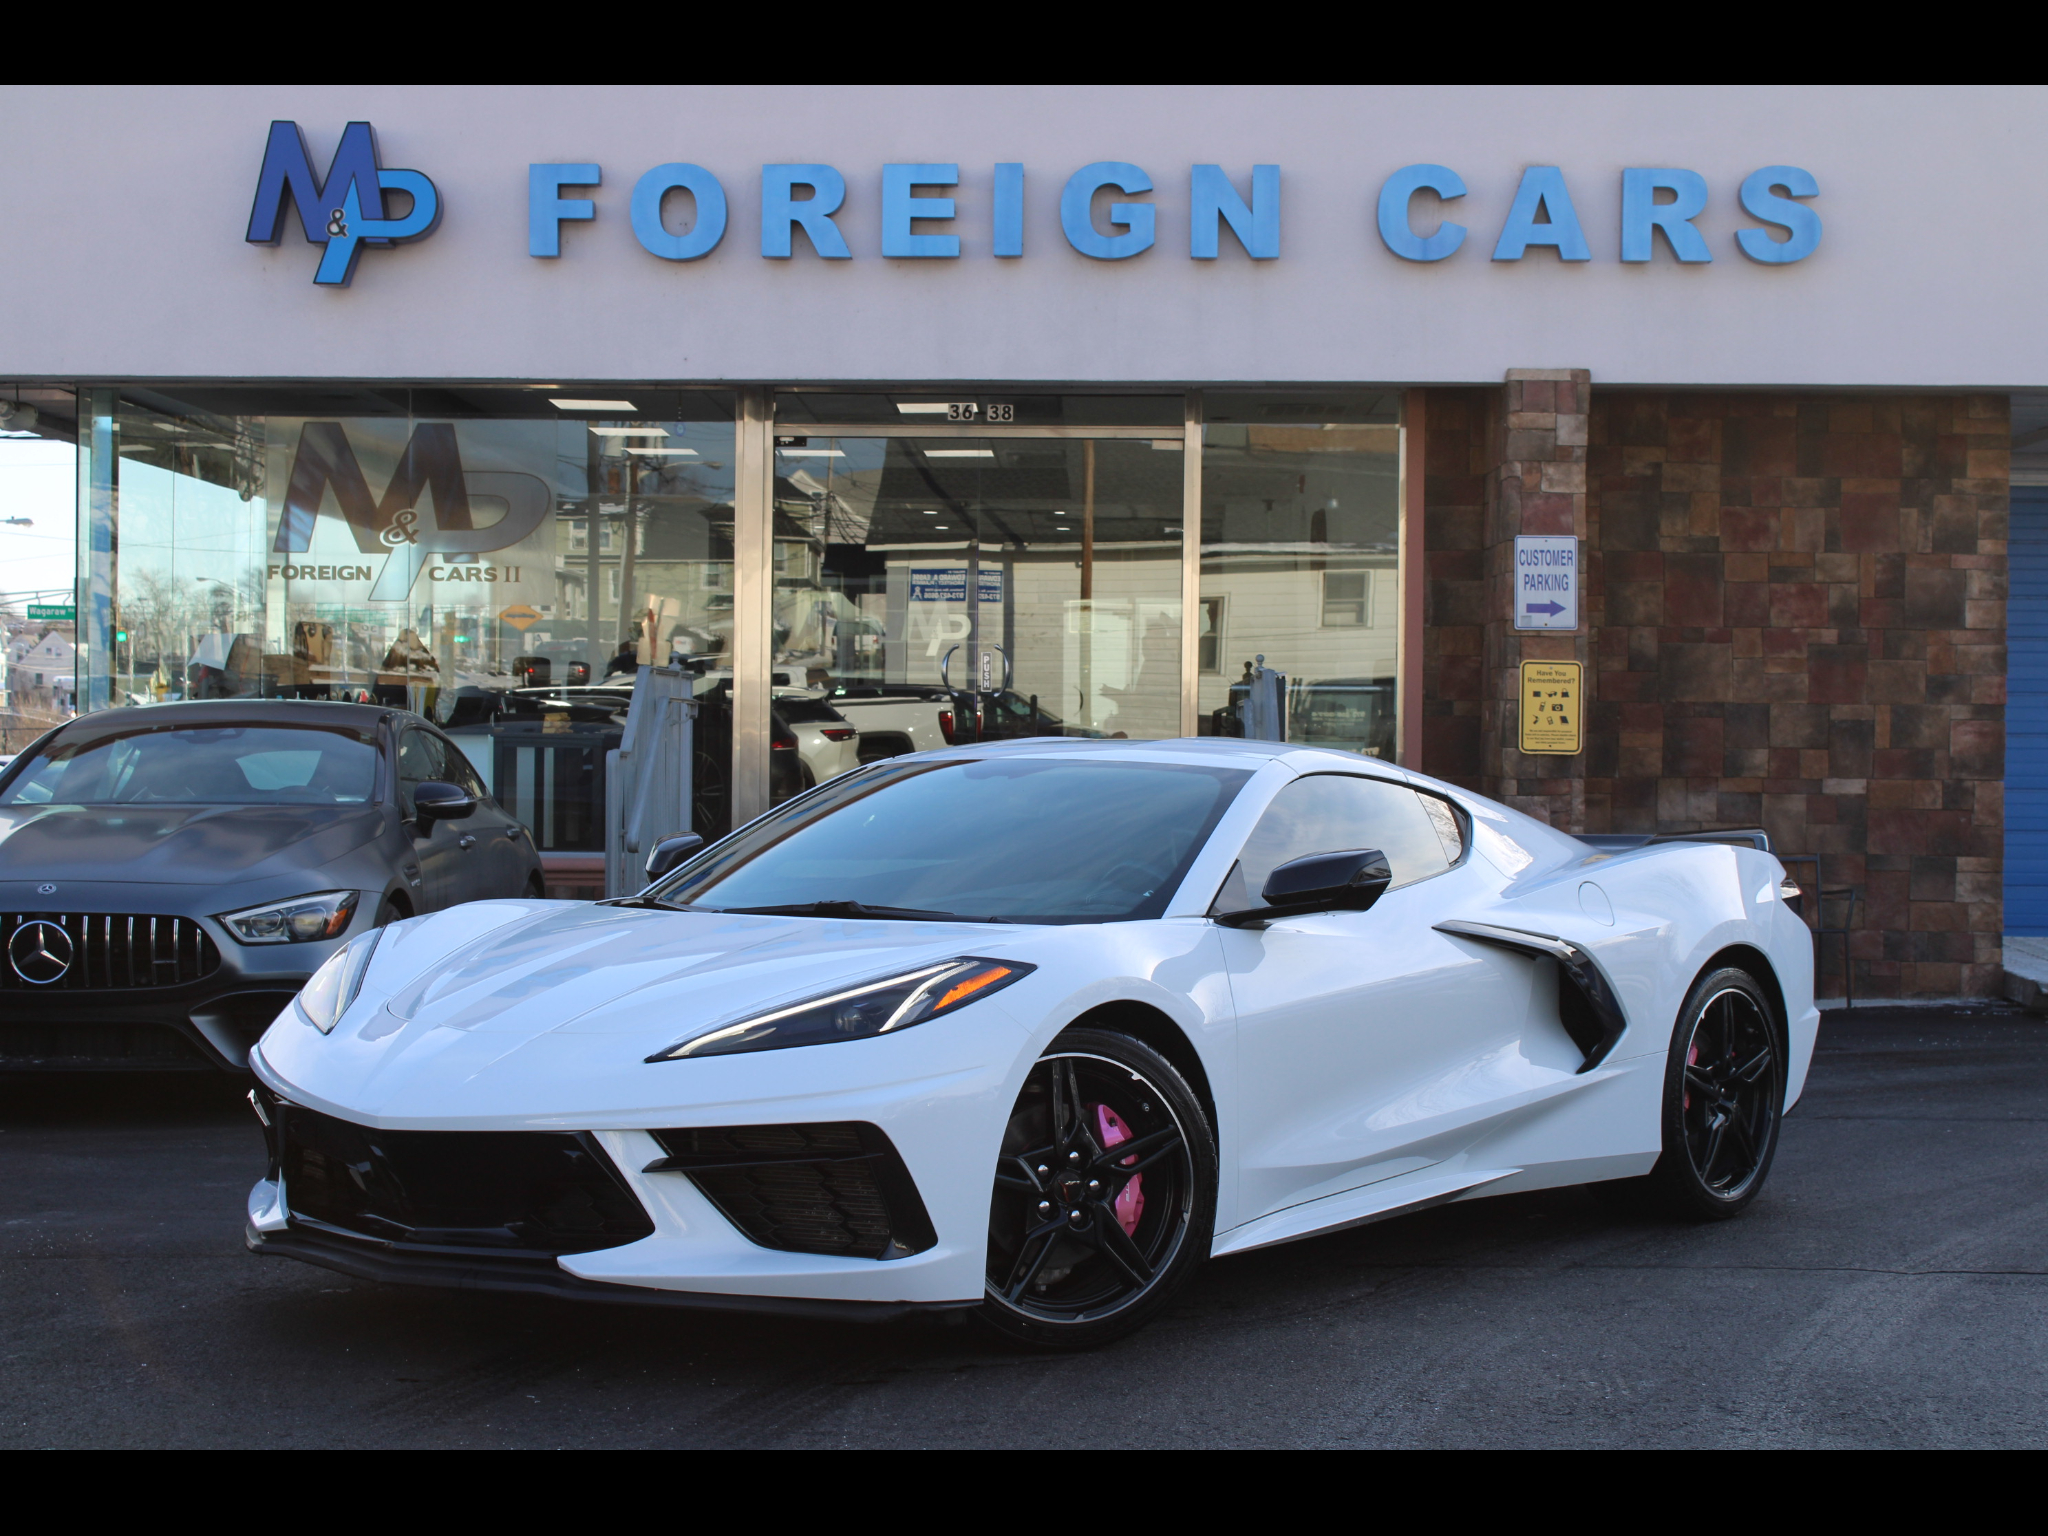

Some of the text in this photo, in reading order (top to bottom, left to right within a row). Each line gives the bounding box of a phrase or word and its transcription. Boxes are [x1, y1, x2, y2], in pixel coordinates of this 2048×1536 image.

[528, 160, 1823, 266] FOREIGN CARS
[1519, 549, 1574, 567] CUSTOMER
[267, 565, 521, 583] FOREIGN CARS II
[1523, 573, 1569, 591] PARKING
[29, 606, 66, 617] Wagaraw
[1527, 677, 1576, 685] Remembered?
